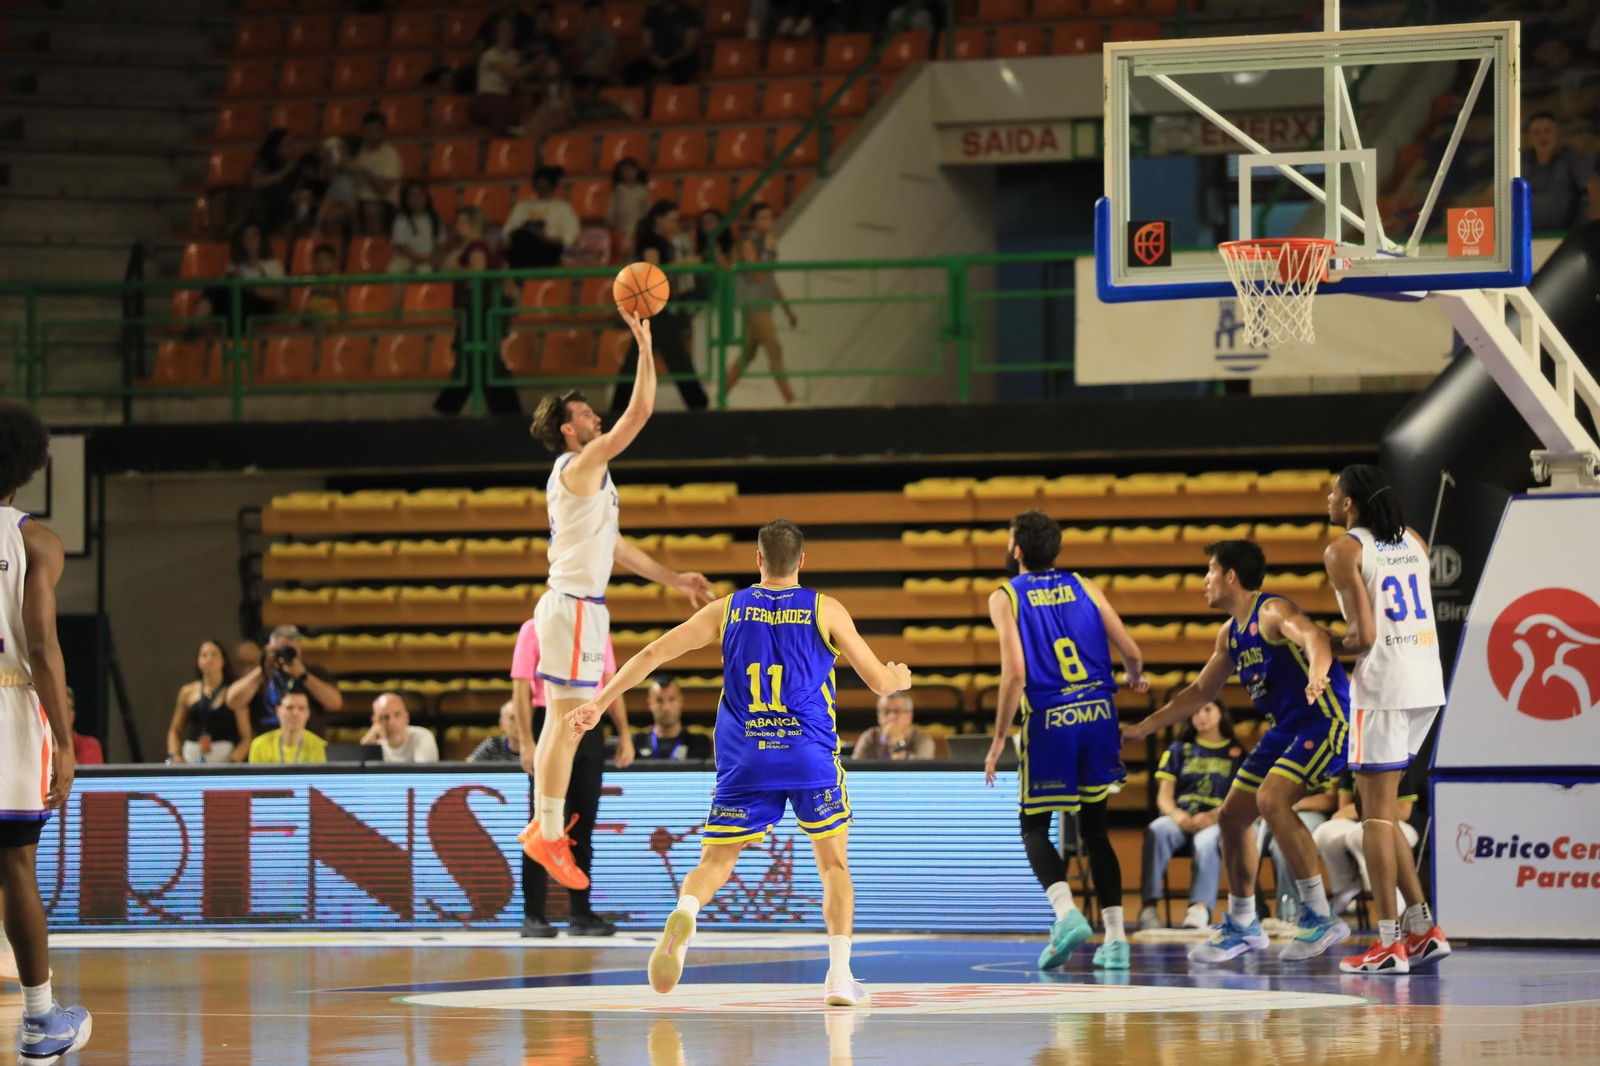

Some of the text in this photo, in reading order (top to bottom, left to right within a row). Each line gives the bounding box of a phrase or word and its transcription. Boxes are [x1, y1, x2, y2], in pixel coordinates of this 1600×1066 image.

[961, 127, 1059, 157] SAIDA
[1201, 115, 1324, 146] EMERX
[730, 606, 812, 626] M. FERNÁNDEZ
[1381, 573, 1427, 622] 31
[1053, 636, 1089, 683] 8
[746, 662, 788, 713] 11
[746, 716, 801, 729] ABANCA
[46, 784, 628, 922] RENS
